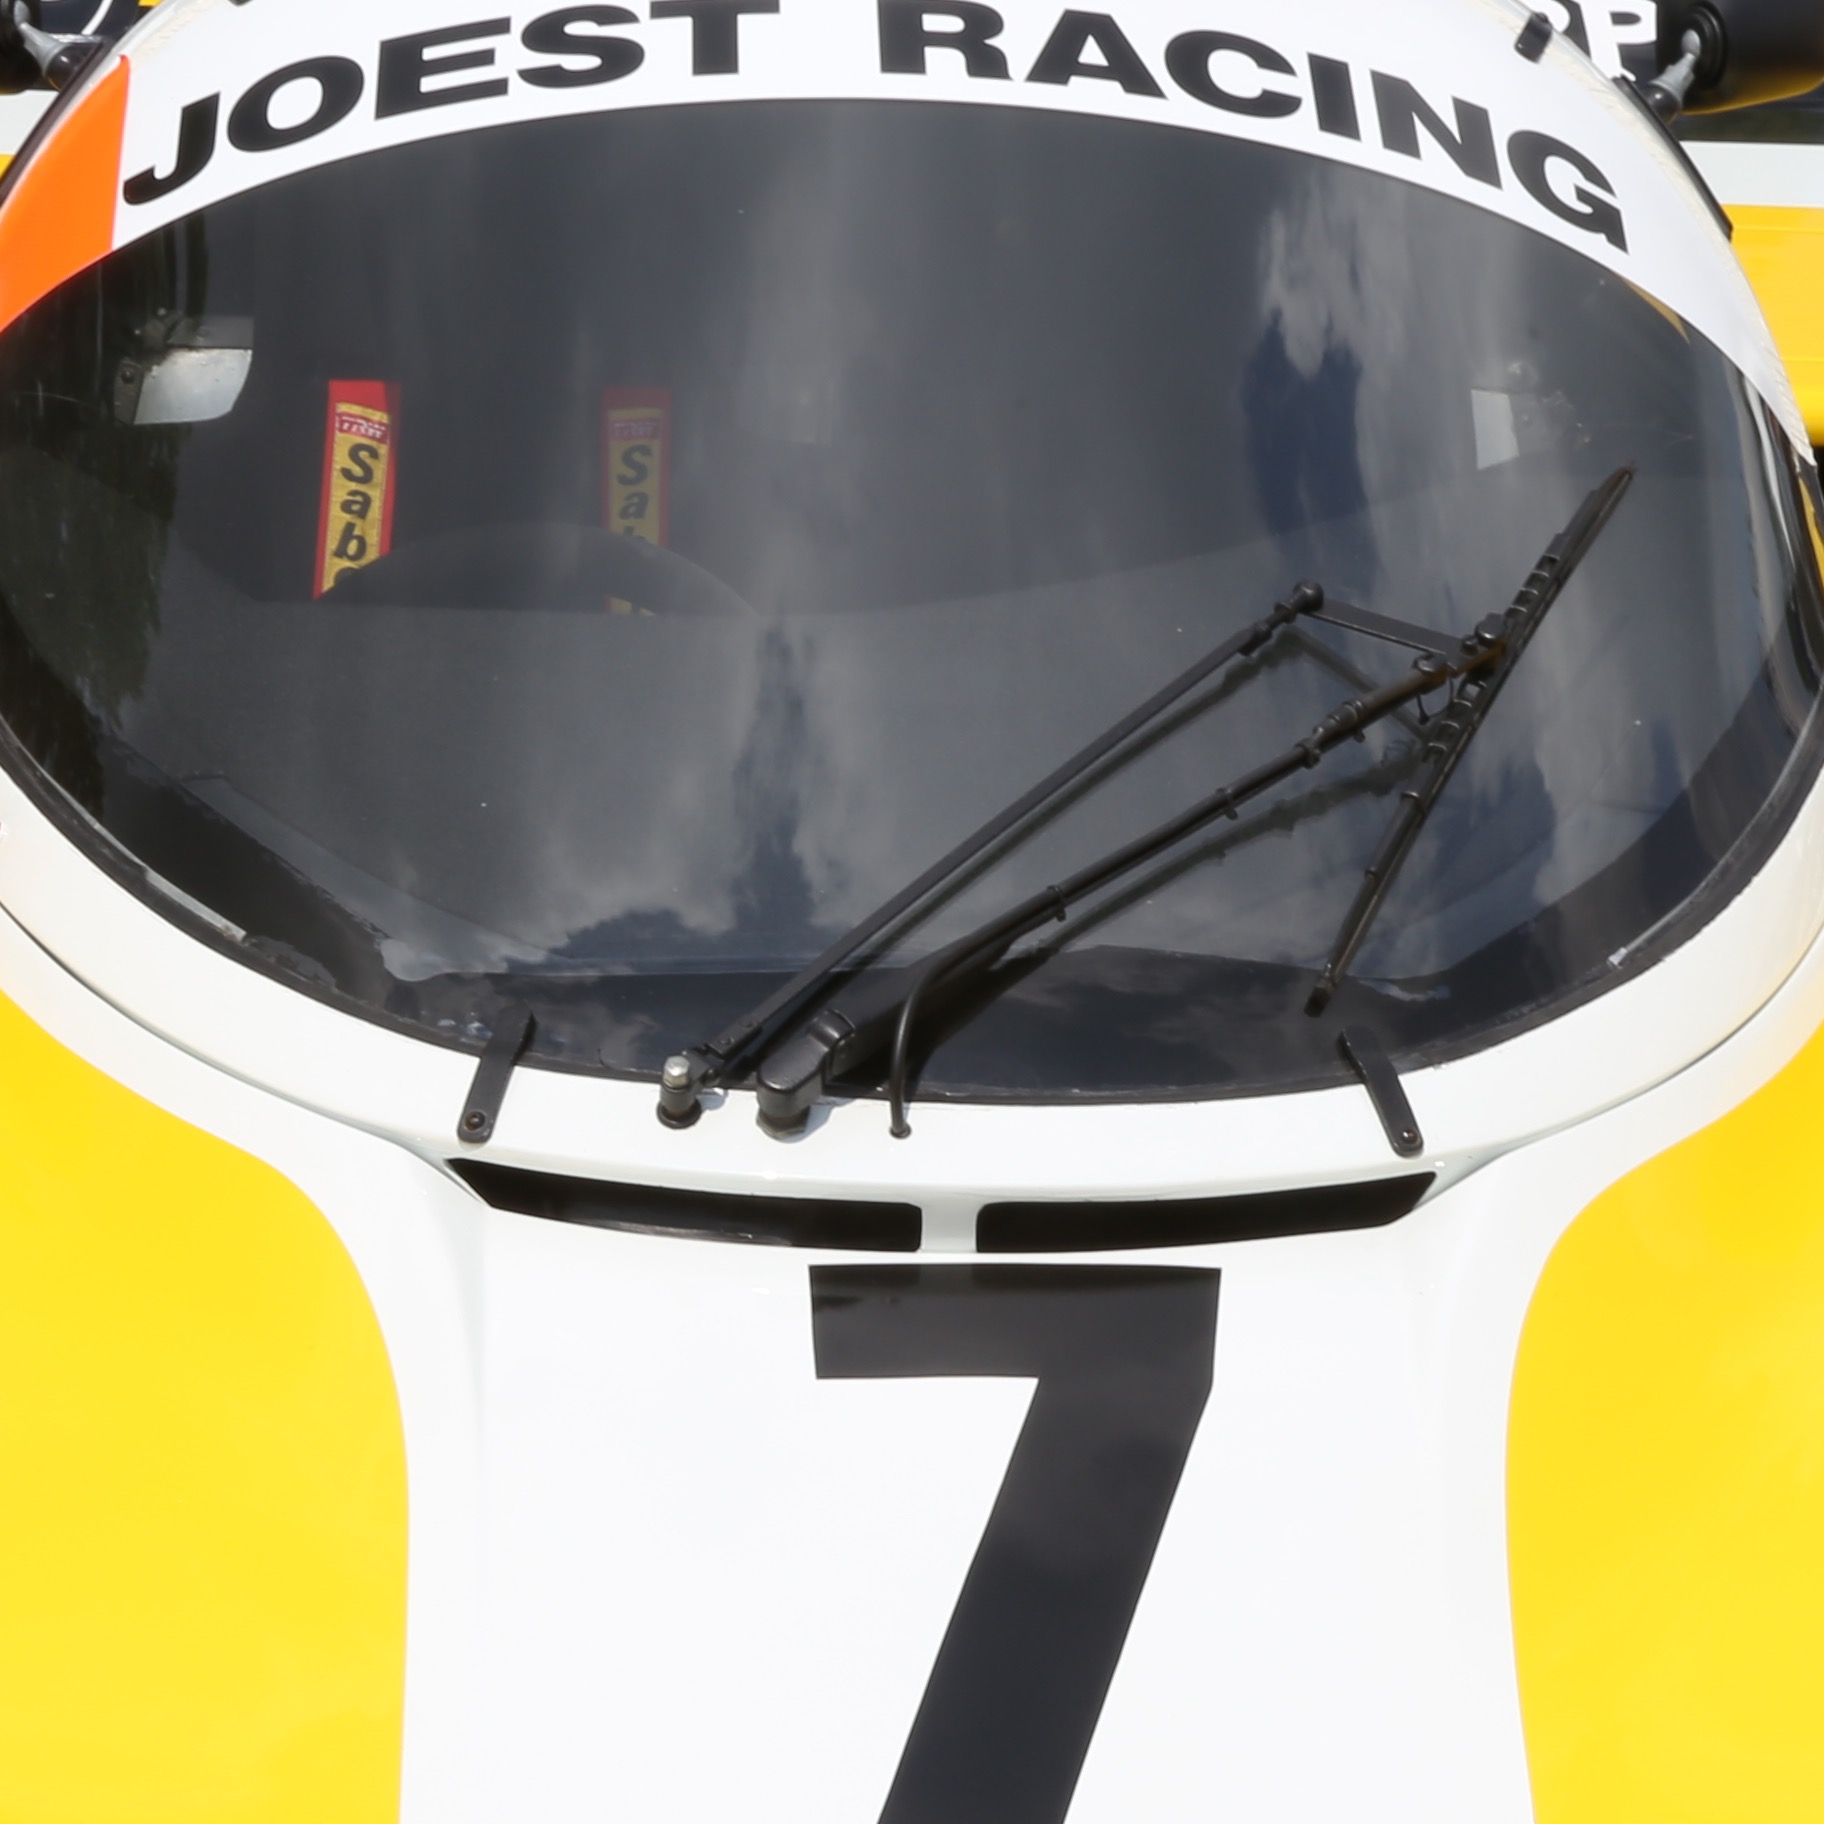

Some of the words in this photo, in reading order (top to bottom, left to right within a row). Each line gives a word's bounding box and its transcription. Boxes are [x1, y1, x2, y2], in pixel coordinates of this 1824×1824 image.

[123, 0, 780, 206] JOEST
[876, 0, 1629, 254] RACING
[333, 443, 379, 587] Sab
